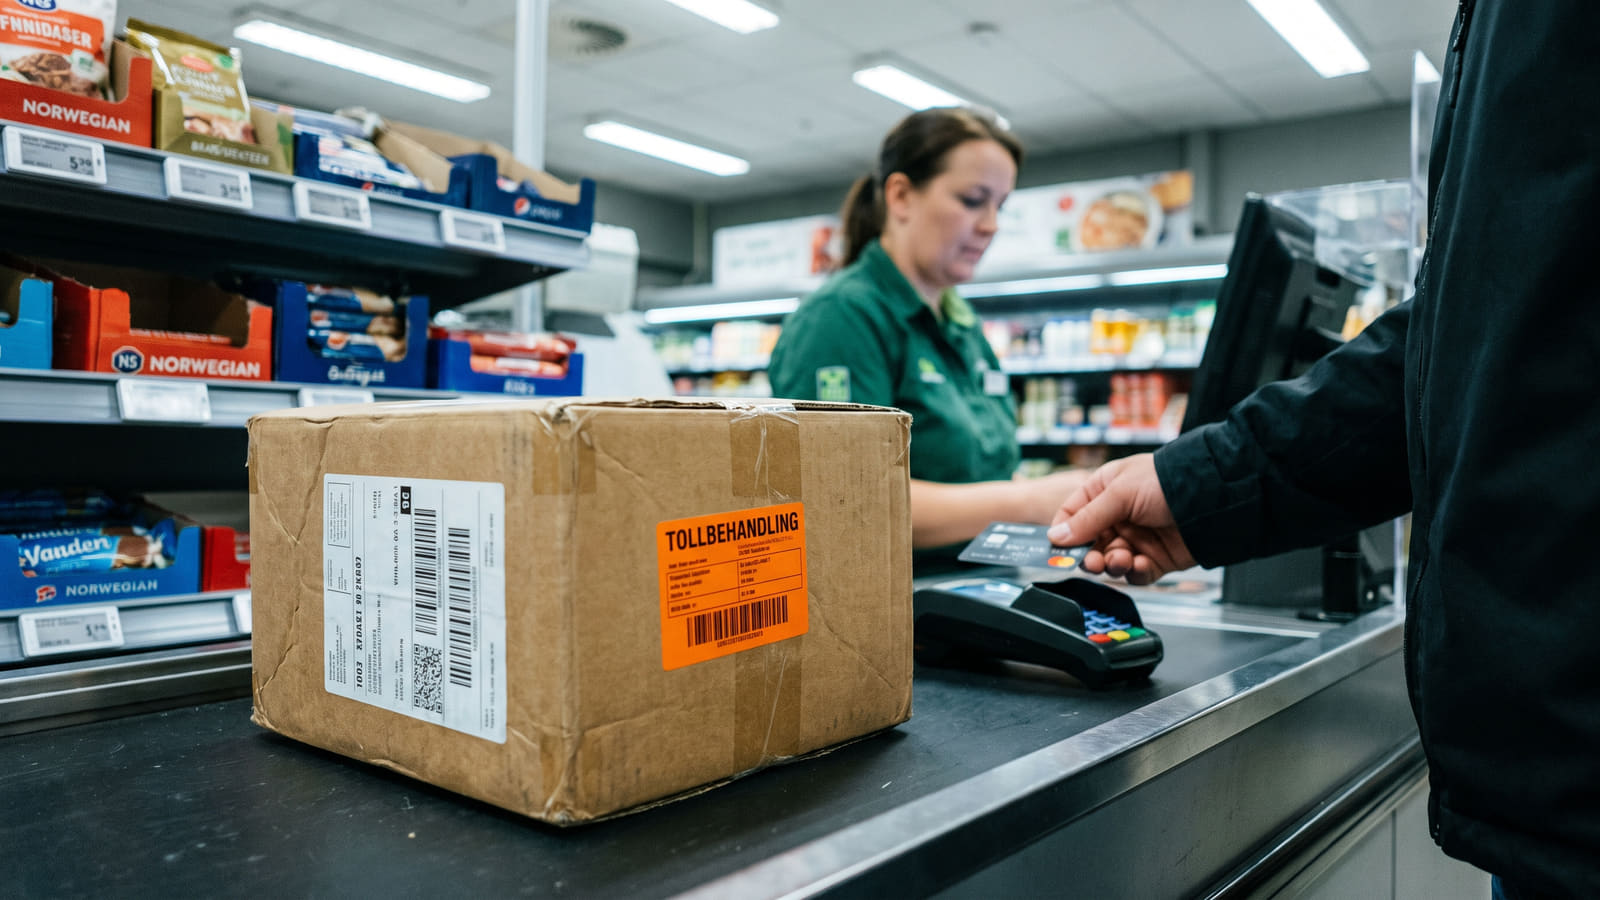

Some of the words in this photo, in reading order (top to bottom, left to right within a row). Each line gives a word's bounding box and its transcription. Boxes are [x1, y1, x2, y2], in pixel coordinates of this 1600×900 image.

[22, 98, 131, 134] NORWEGIAN
[118, 354, 138, 369] NS
[150, 356, 260, 377] NORWEGIAN
[665, 512, 798, 551] TOLLBEHANDLING
[25, 537, 110, 567] Vanden
[66, 580, 158, 596] NORWEGIAN
